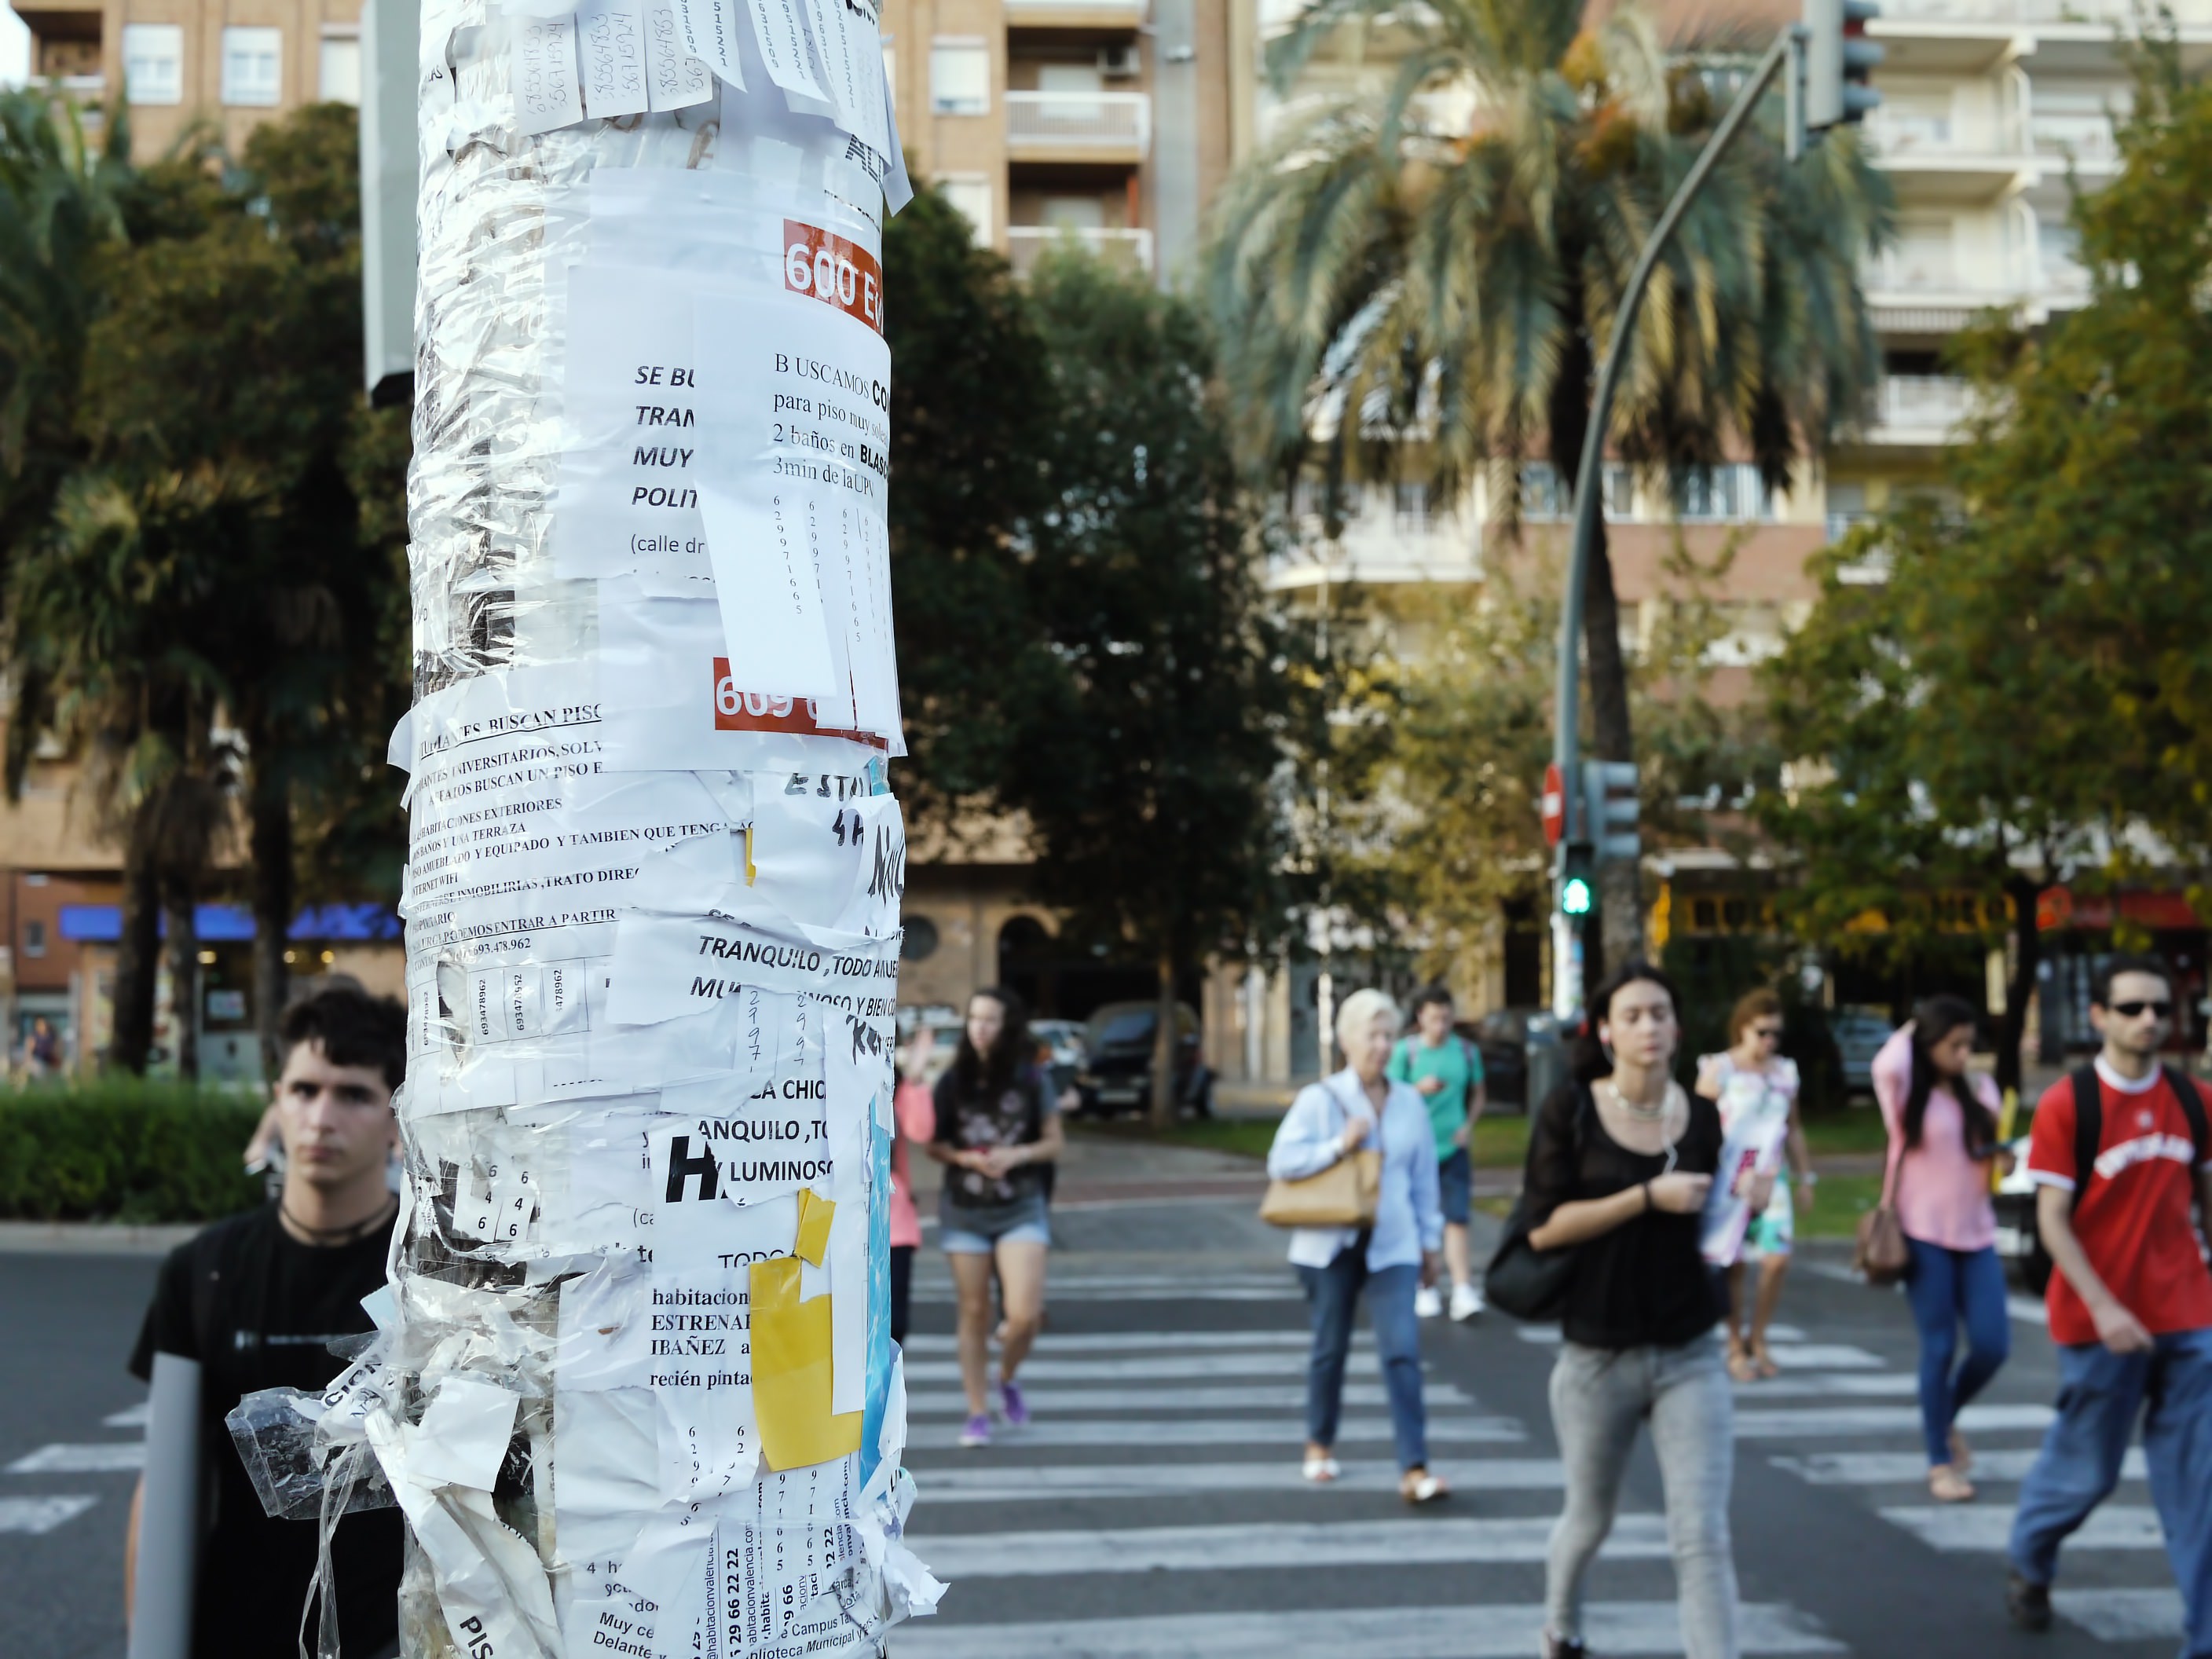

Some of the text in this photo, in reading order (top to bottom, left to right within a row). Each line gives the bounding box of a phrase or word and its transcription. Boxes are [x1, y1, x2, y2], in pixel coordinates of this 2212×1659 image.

[786, 243, 856, 306] 600
[635, 366, 664, 385] SE
[774, 393, 811, 412] para
[818, 399, 846, 420] piso
[849, 412, 870, 436] muy
[773, 423, 783, 442] 2
[790, 425, 835, 453] baños
[840, 442, 855, 459] en
[633, 446, 694, 467] MUY
[822, 465, 838, 484] de
[631, 533, 705, 554] (calle dr
[489, 709, 557, 734] BUSCAN
[474, 772, 523, 793] BUSCAN
[528, 768, 548, 782] UN
[553, 763, 588, 779] PISO
[484, 798, 562, 820] EXTERIORES
[420, 840, 441, 857] BAÑOS
[443, 837, 449, 849] Y
[452, 833, 470, 847] UNA
[472, 822, 526, 841] TERRAZA
[423, 851, 471, 875] AMUEBLADO
[474, 848, 483, 859] Y
[485, 837, 550, 858] EQUIPADO
[557, 835, 566, 848] Y
[569, 829, 640, 846] TAMBIEN
[644, 825, 676, 840] QUE
[439, 872, 458, 886] WIFI
[494, 916, 544, 933] ENTRAR
[549, 915, 557, 926] A
[562, 909, 616, 924] PARTIR
[699, 935, 820, 972] TRANQUILO
[479, 979, 489, 1035] 693478962
[857, 997, 865, 1015] Y
[866, 998, 886, 1016] BIEN
[666, 1136, 728, 1203] H
[650, 1335, 726, 1356] IBAÑEZ
[650, 1370, 753, 1390] recién pinta
[825, 1526, 833, 1548] 22
[587, 1561, 622, 1573] 4 h
[727, 1548, 742, 1644] 29 66 22 22
[782, 1584, 793, 1605] 66
[600, 1612, 632, 1635] Muy
[792, 1617, 839, 1637] Campus
[593, 1631, 652, 1659] Delante
[806, 1628, 855, 1654] Municipal
